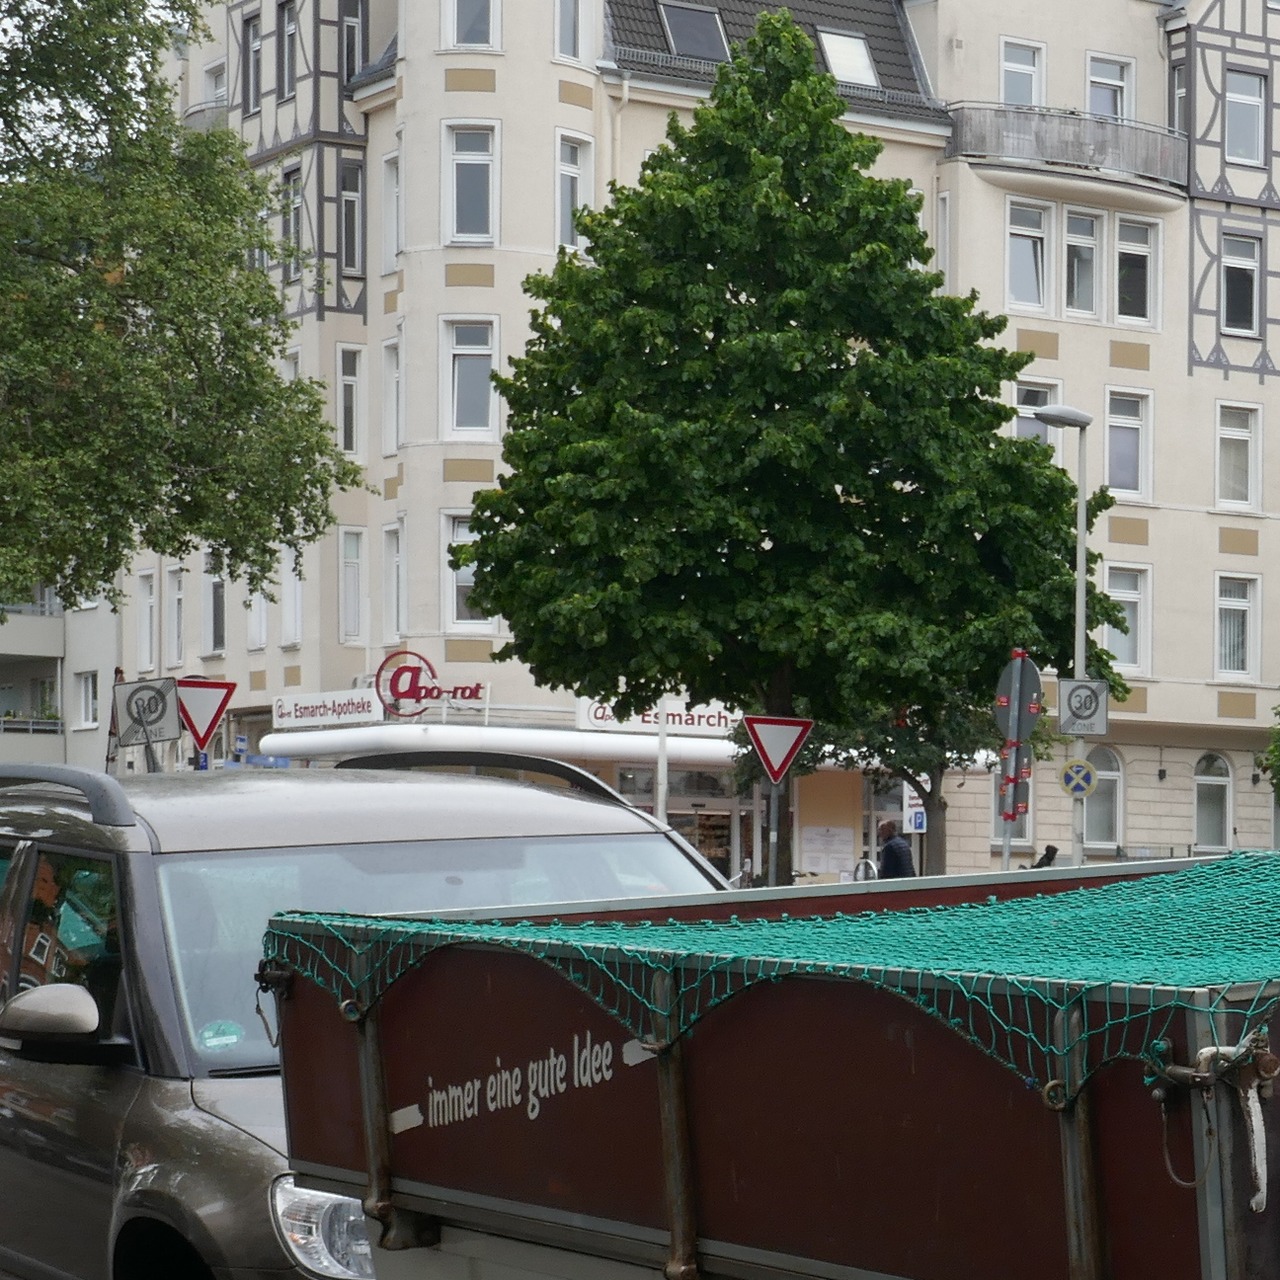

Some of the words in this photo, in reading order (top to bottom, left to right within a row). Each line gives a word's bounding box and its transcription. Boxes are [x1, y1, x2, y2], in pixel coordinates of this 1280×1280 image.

[294, 697, 373, 720] Esmarch-Apotheke
[1074, 694, 1093, 711] 30
[134, 727, 165, 741] ZNE
[1071, 722, 1096, 732] ZONE
[428, 1076, 481, 1128] immer
[487, 1056, 522, 1112] eine
[527, 1047, 567, 1120] gute
[573, 1030, 613, 1088] Idee
